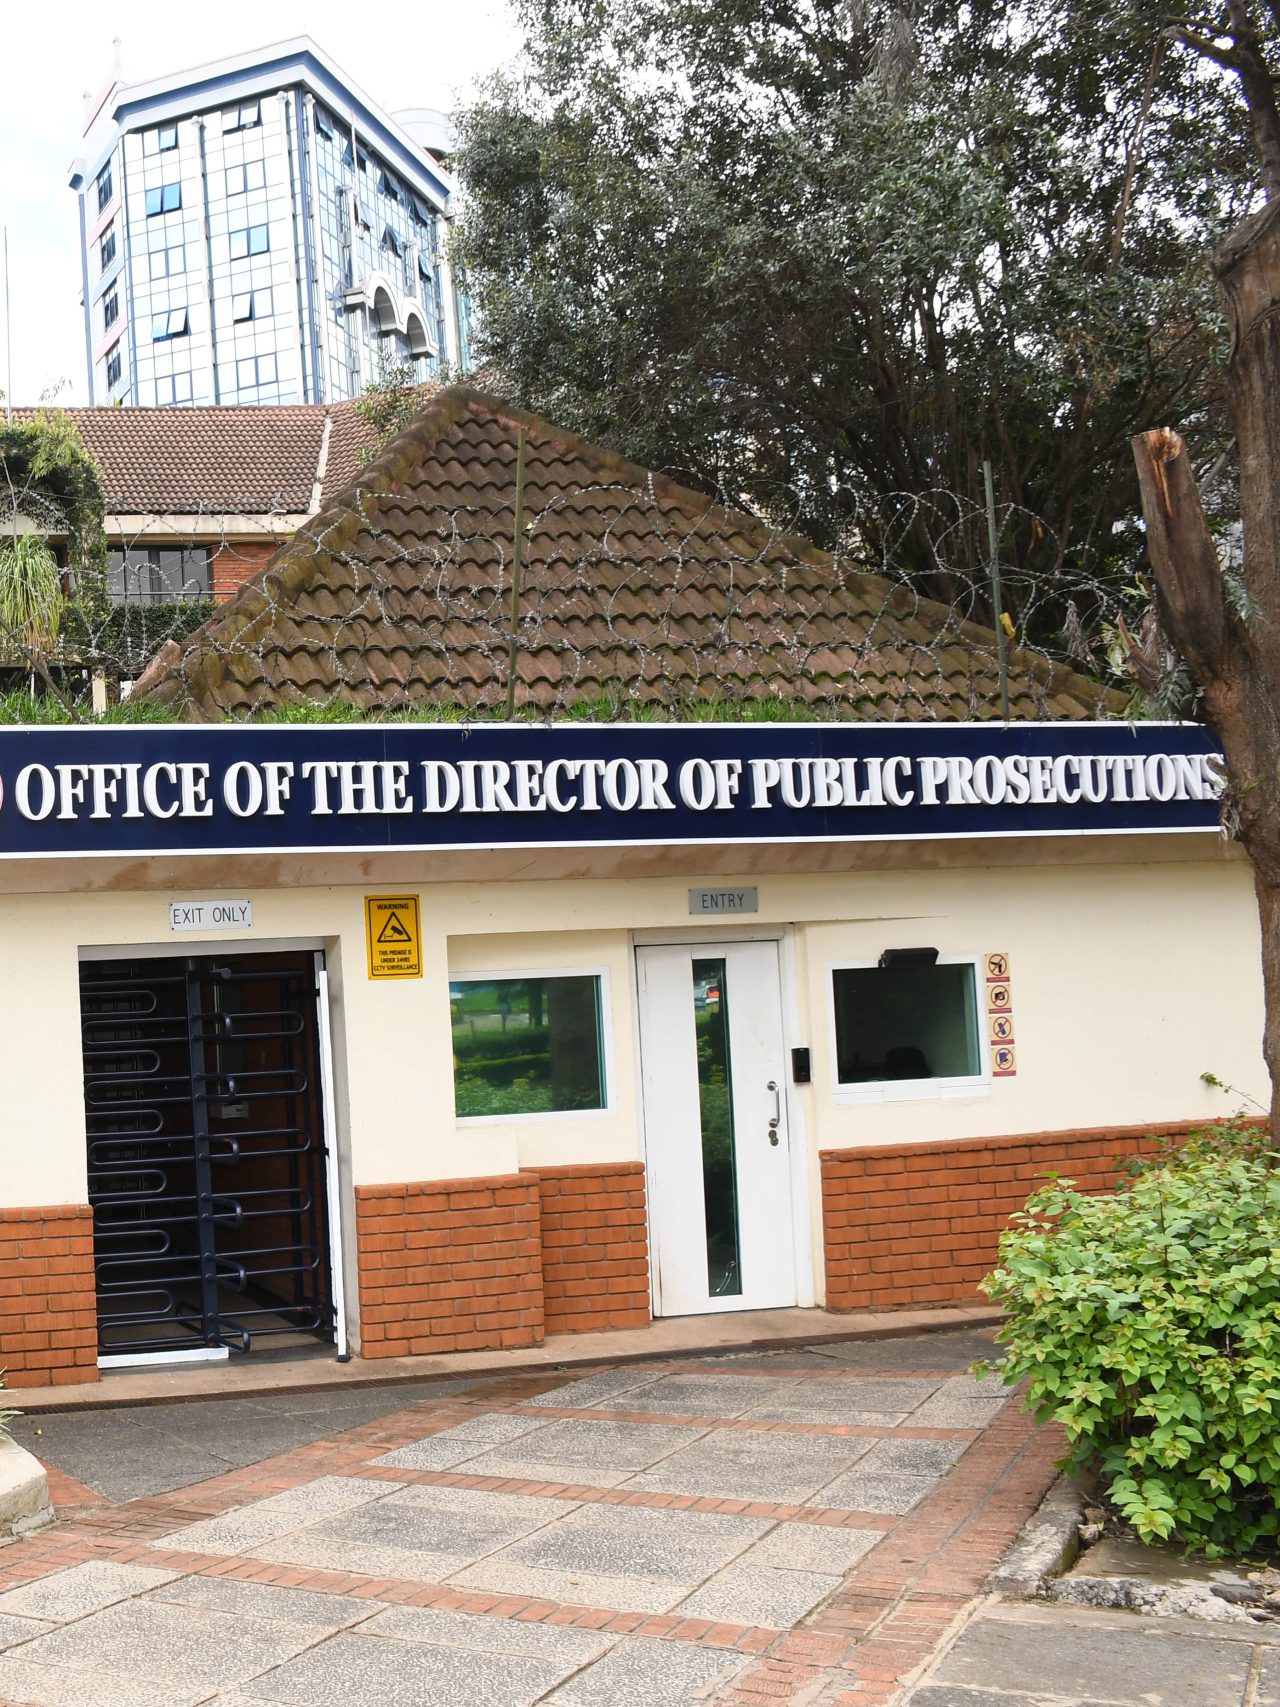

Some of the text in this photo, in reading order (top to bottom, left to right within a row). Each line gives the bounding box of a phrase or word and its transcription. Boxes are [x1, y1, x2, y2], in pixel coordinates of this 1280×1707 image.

[15, 753, 1228, 820] OFFICE OF THE DIRECTOR OF PUBLIC PROSECUTIONS
[701, 893, 745, 909] ENTRY
[173, 906, 248, 924] EXIT ONLY
